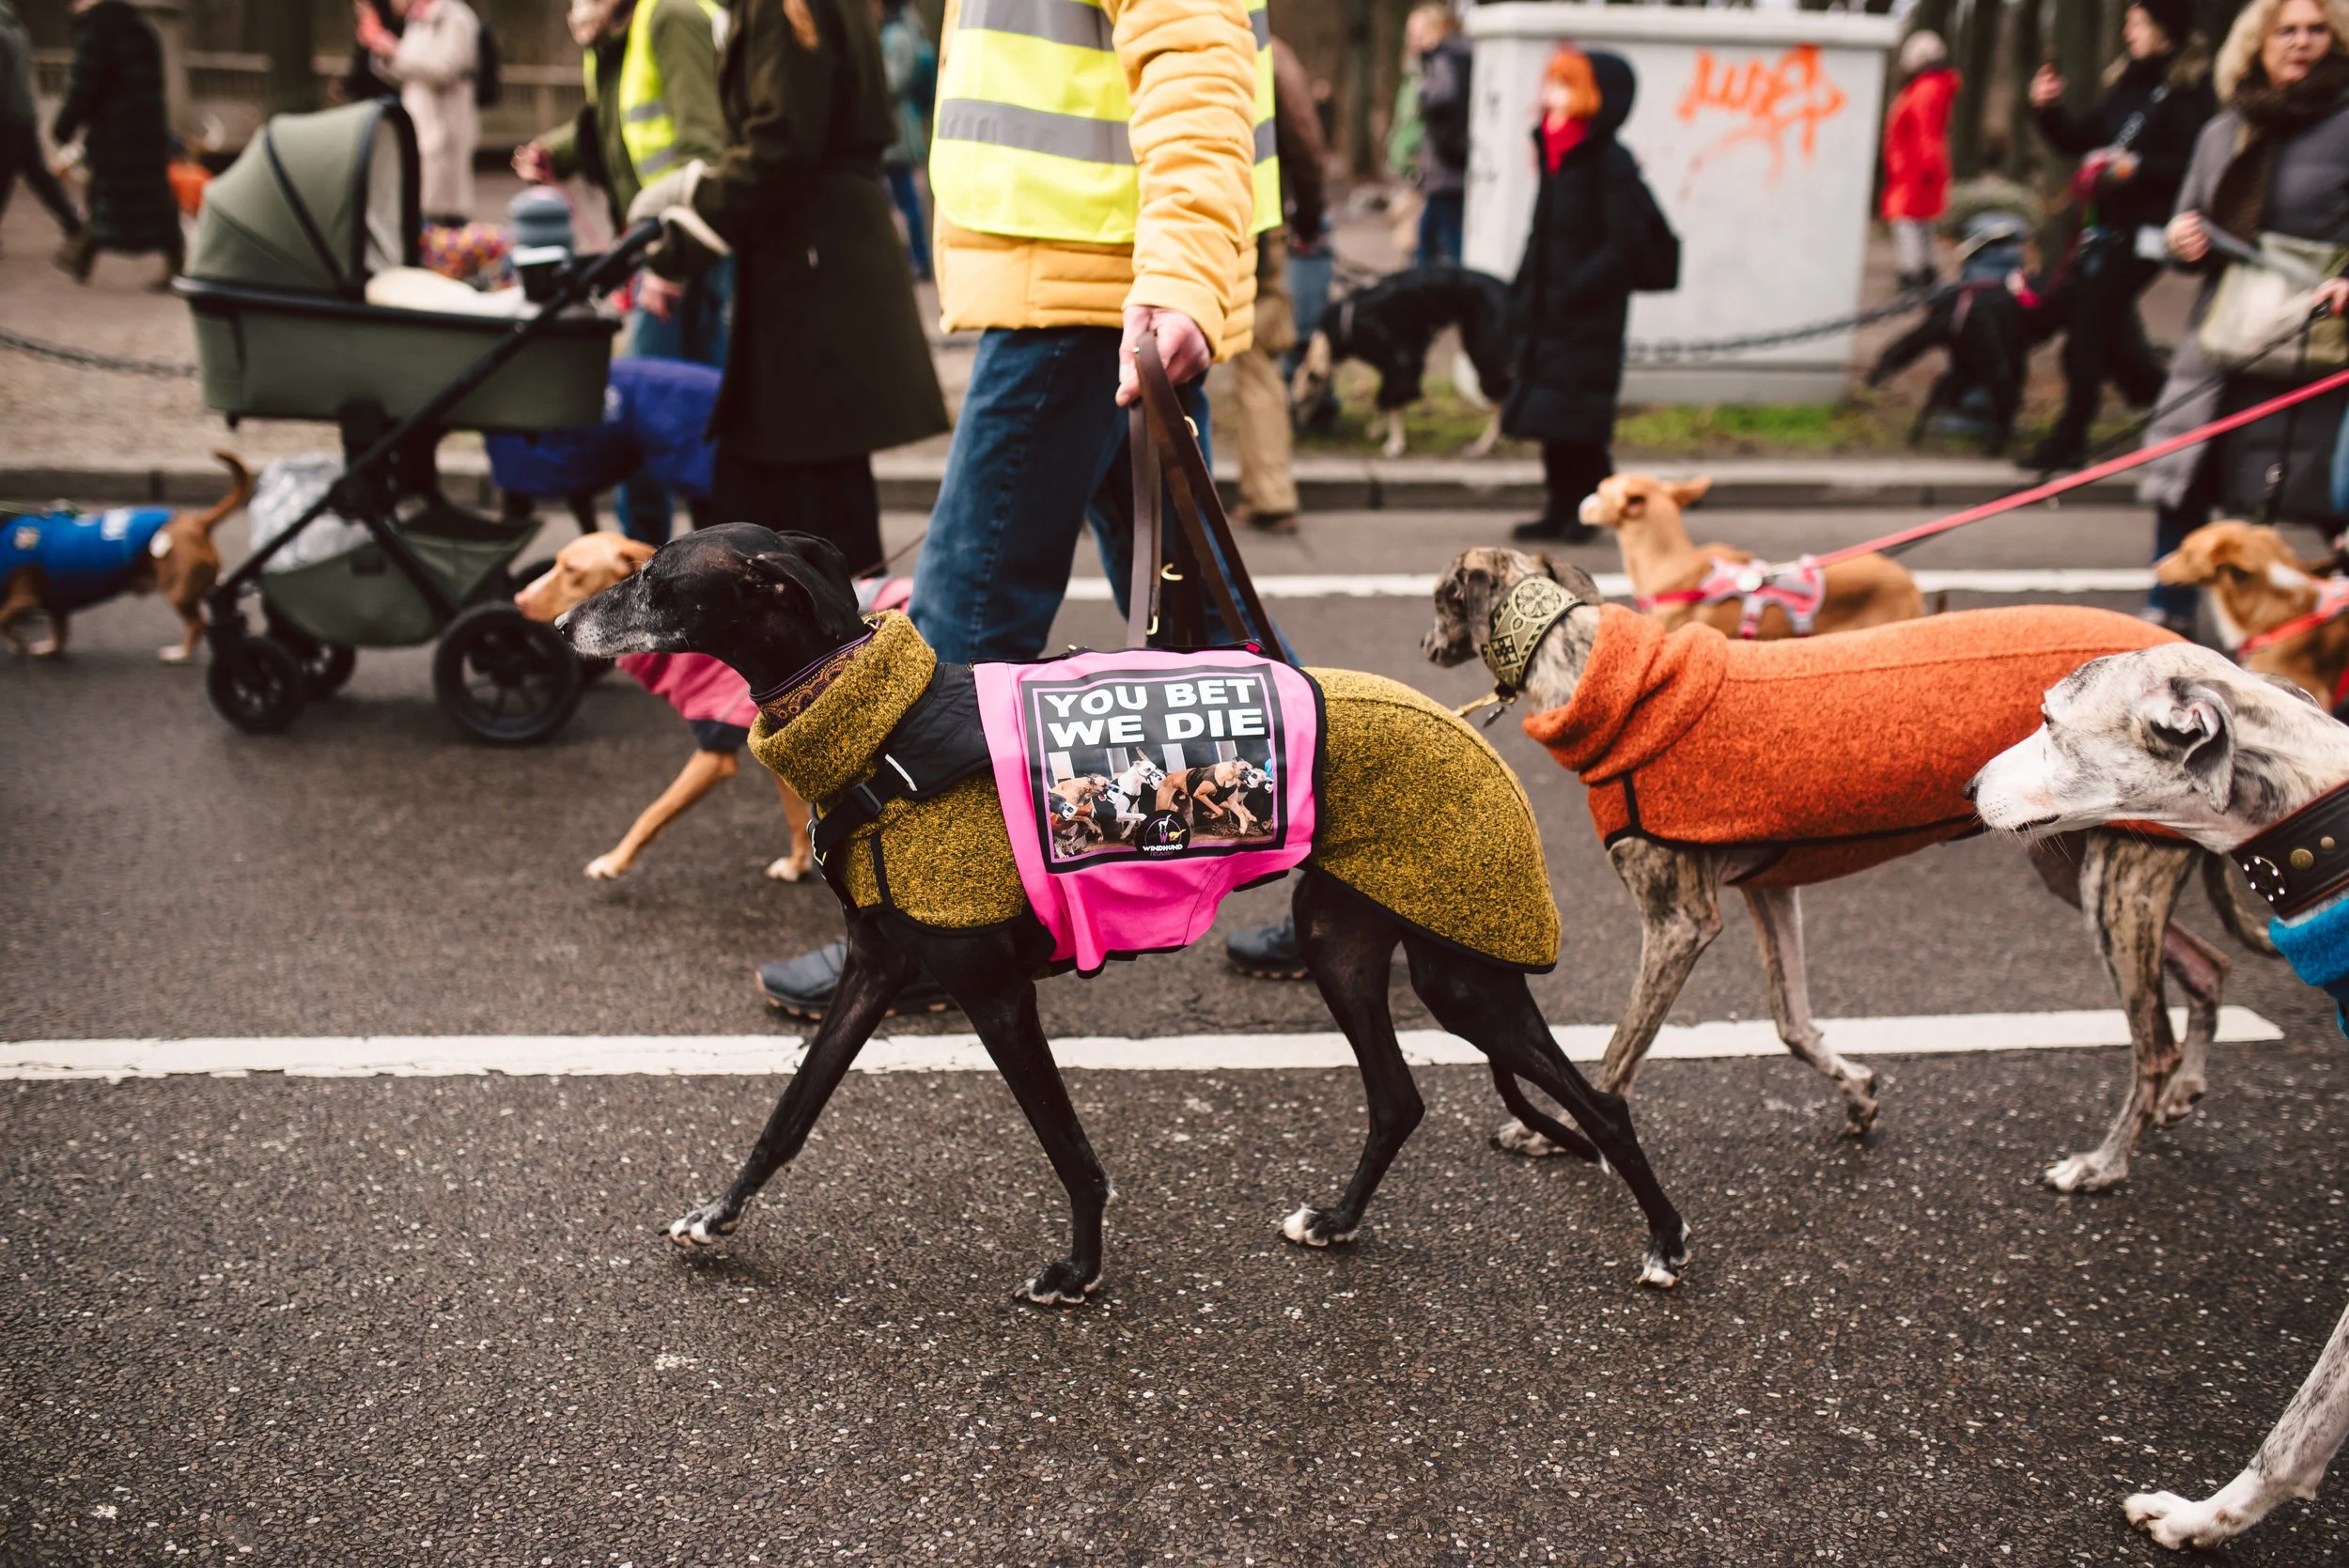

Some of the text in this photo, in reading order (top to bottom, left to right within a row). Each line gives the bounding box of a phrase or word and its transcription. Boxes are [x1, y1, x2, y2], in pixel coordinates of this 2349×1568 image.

[1044, 679, 1255, 717] YOU BET
[1048, 708, 1265, 748] WE DIE
